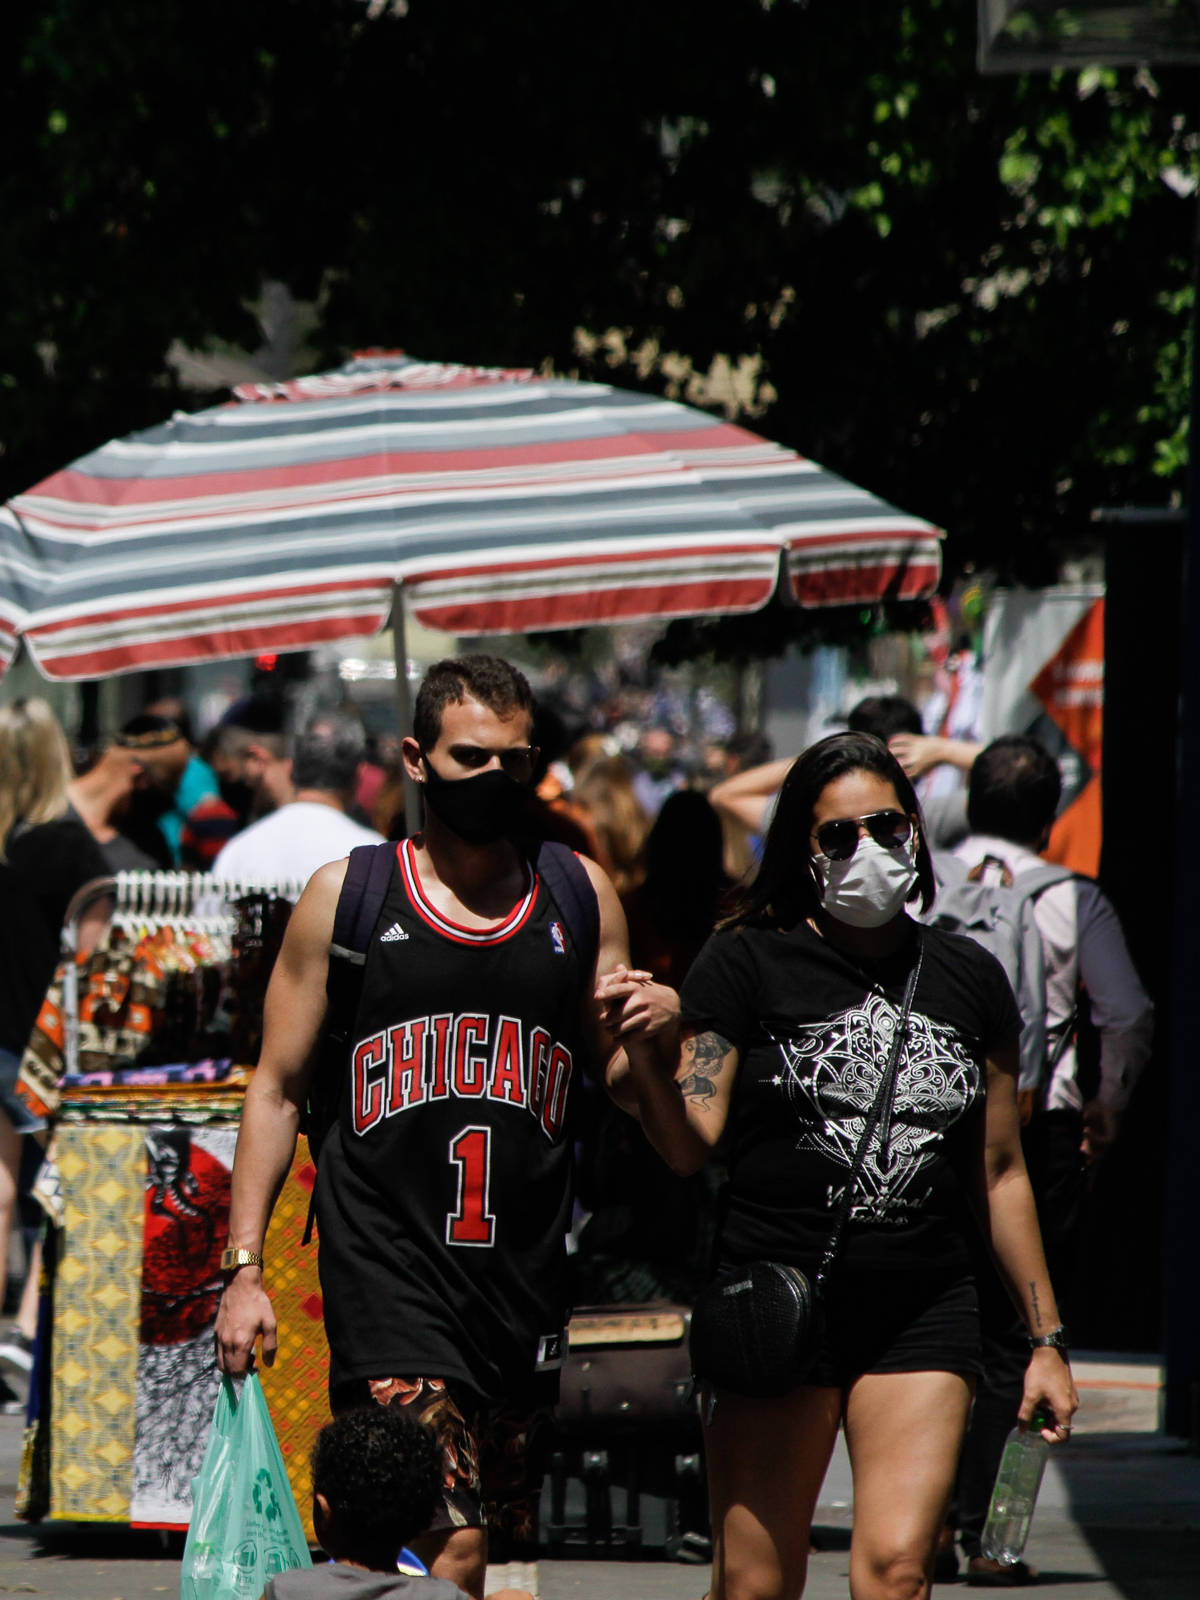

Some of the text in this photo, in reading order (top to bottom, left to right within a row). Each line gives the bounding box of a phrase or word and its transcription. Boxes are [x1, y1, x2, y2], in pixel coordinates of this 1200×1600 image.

[380, 933, 410, 942] adidas
[352, 1012, 573, 1145] CHICAGO
[445, 1124, 497, 1248] 1
